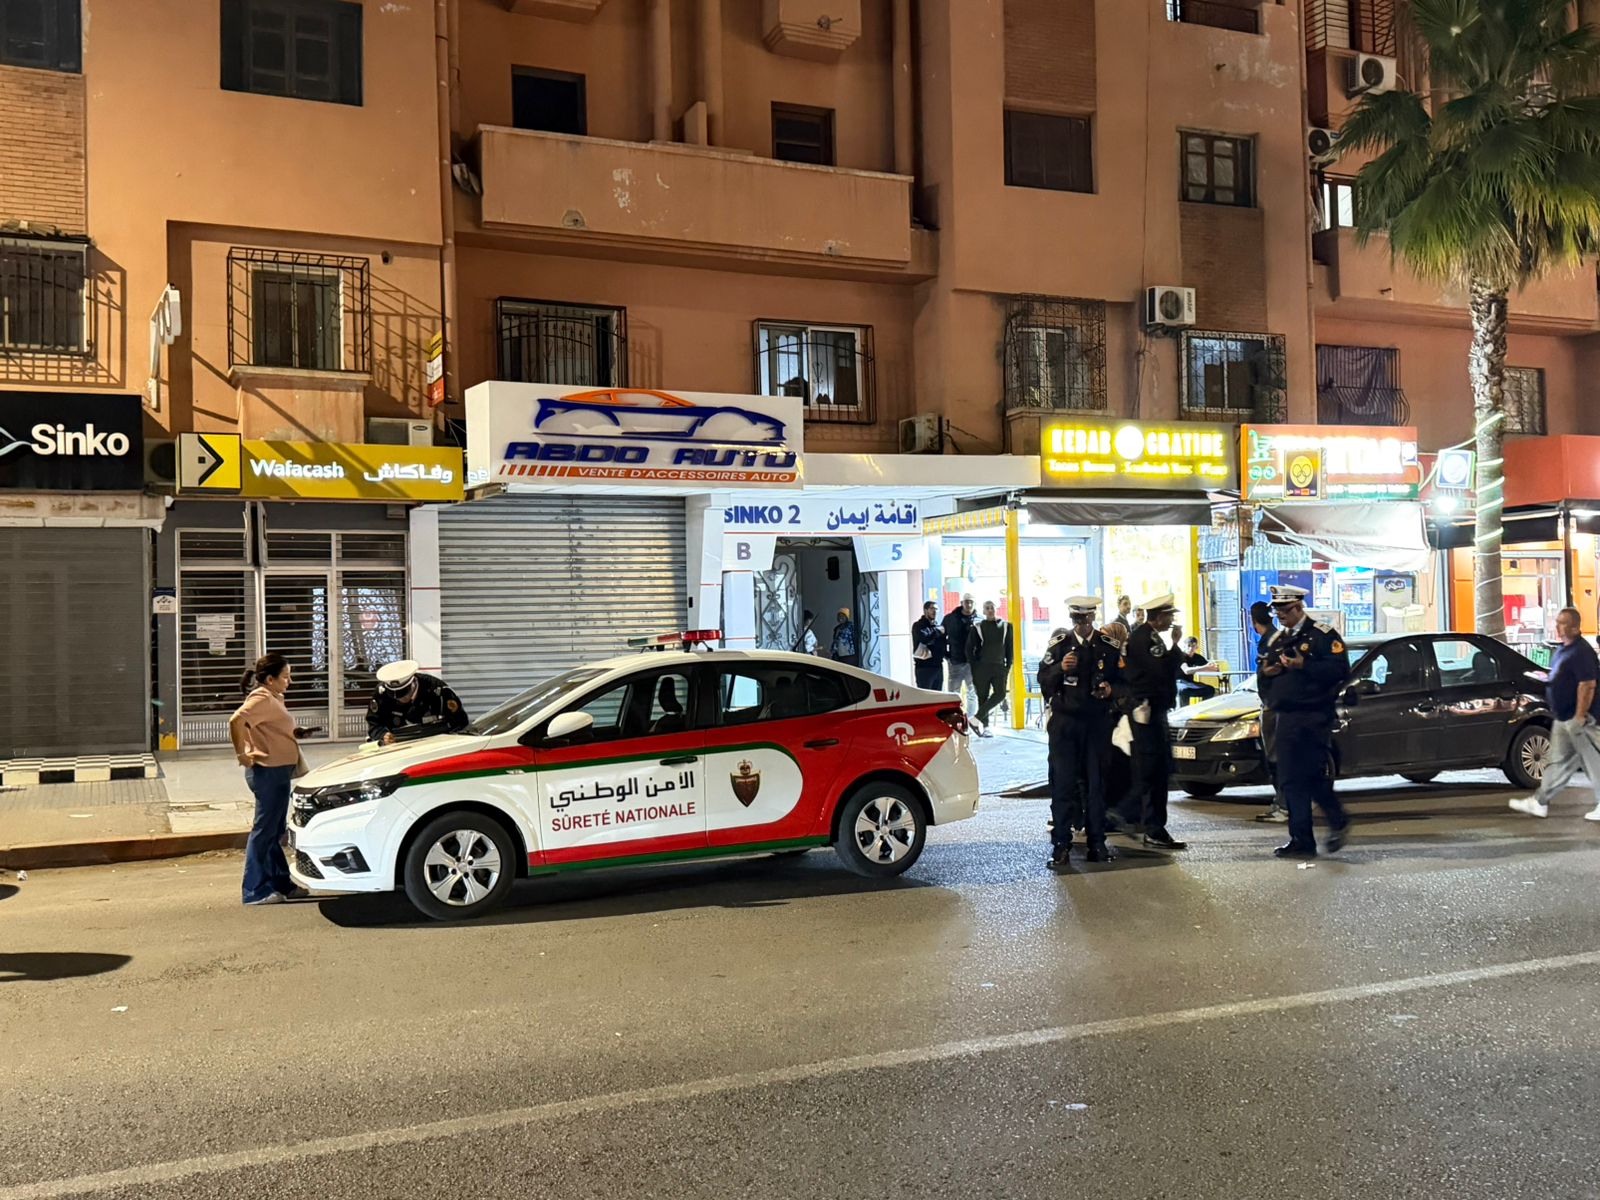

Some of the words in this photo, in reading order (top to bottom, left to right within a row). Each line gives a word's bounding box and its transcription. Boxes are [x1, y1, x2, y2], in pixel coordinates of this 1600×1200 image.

[31, 423, 130, 456] Sinko
[504, 442, 650, 463] ABDO
[673, 448, 796, 467] AUTO
[250, 458, 345, 478] Wafacash
[363, 462, 453, 483] وفاكاش
[578, 467, 626, 478] VENTE
[630, 470, 746, 480] D'ACCESSOIRES
[750, 473, 790, 481] AUTO
[724, 505, 783, 524] SINKO
[788, 504, 801, 524] 2
[737, 542, 752, 560] B
[891, 543, 903, 561] 5
[894, 733, 909, 747] 19
[550, 777, 639, 813] الوطني
[551, 809, 611, 832] SÛRETÉ
[615, 801, 696, 824] NATIONALE
